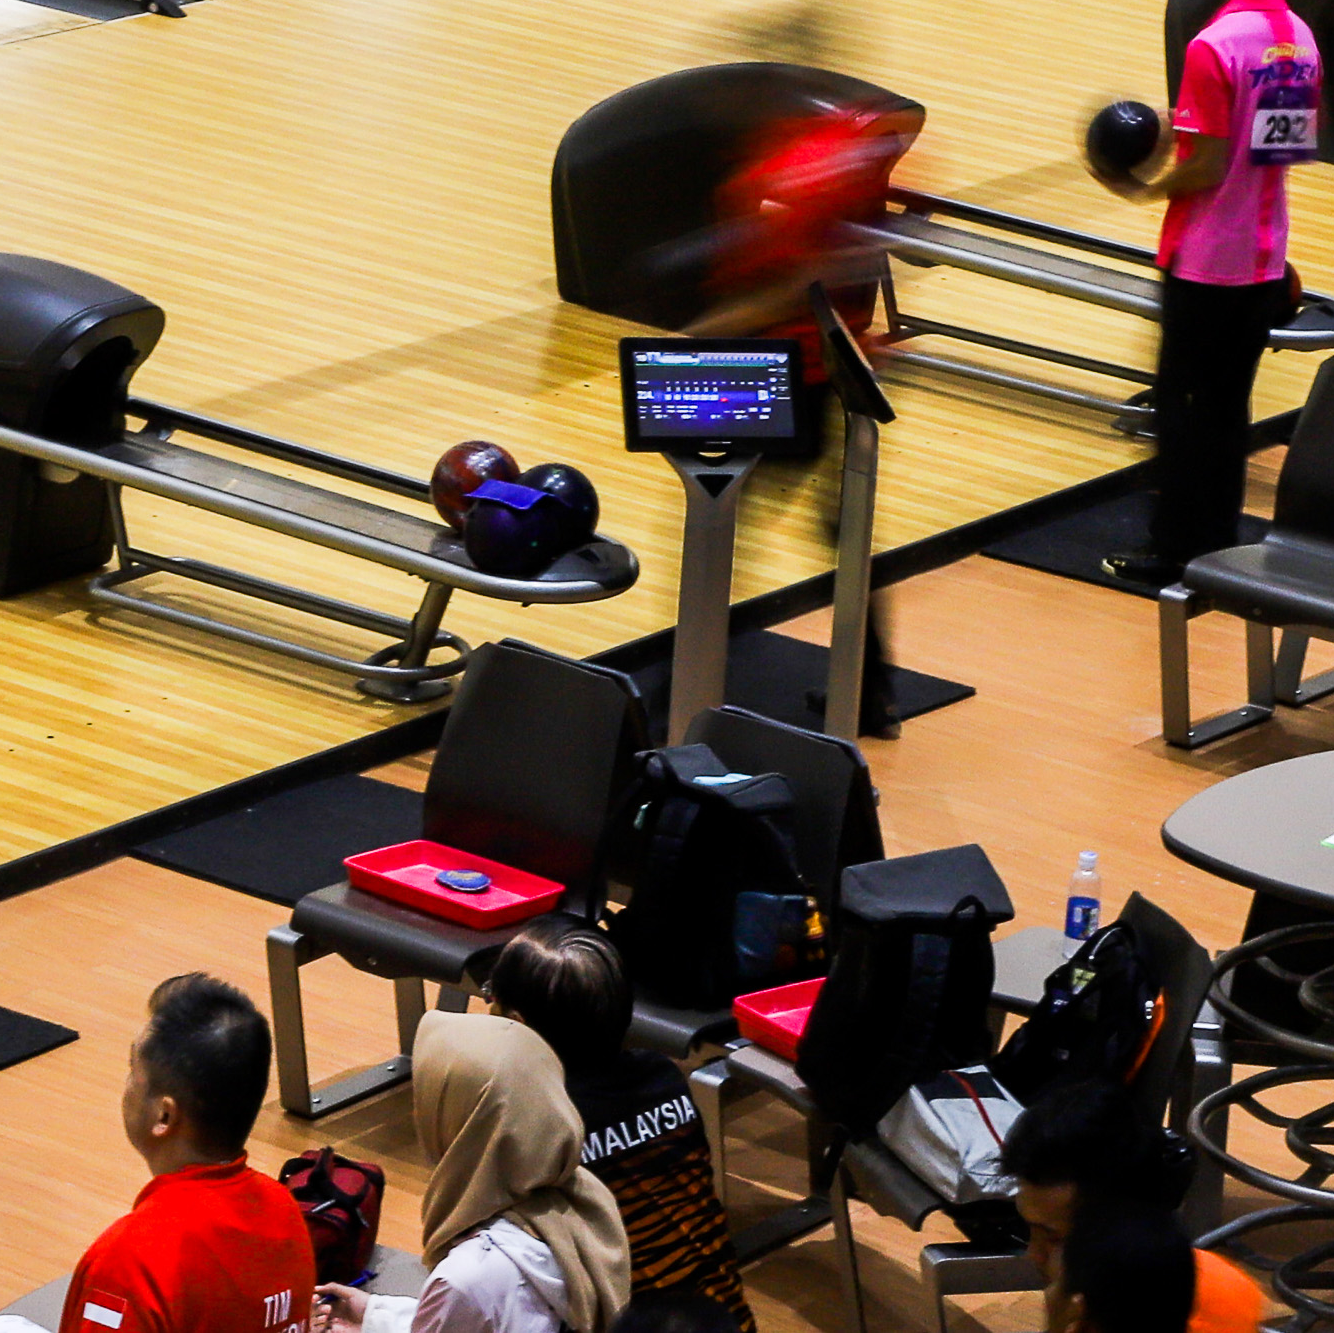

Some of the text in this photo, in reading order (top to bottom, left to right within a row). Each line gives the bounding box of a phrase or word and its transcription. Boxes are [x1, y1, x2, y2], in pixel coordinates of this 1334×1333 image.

[1263, 114, 1307, 145] 292
[581, 1095, 698, 1164] MALAYSIA
[264, 1288, 292, 1329] TIM
